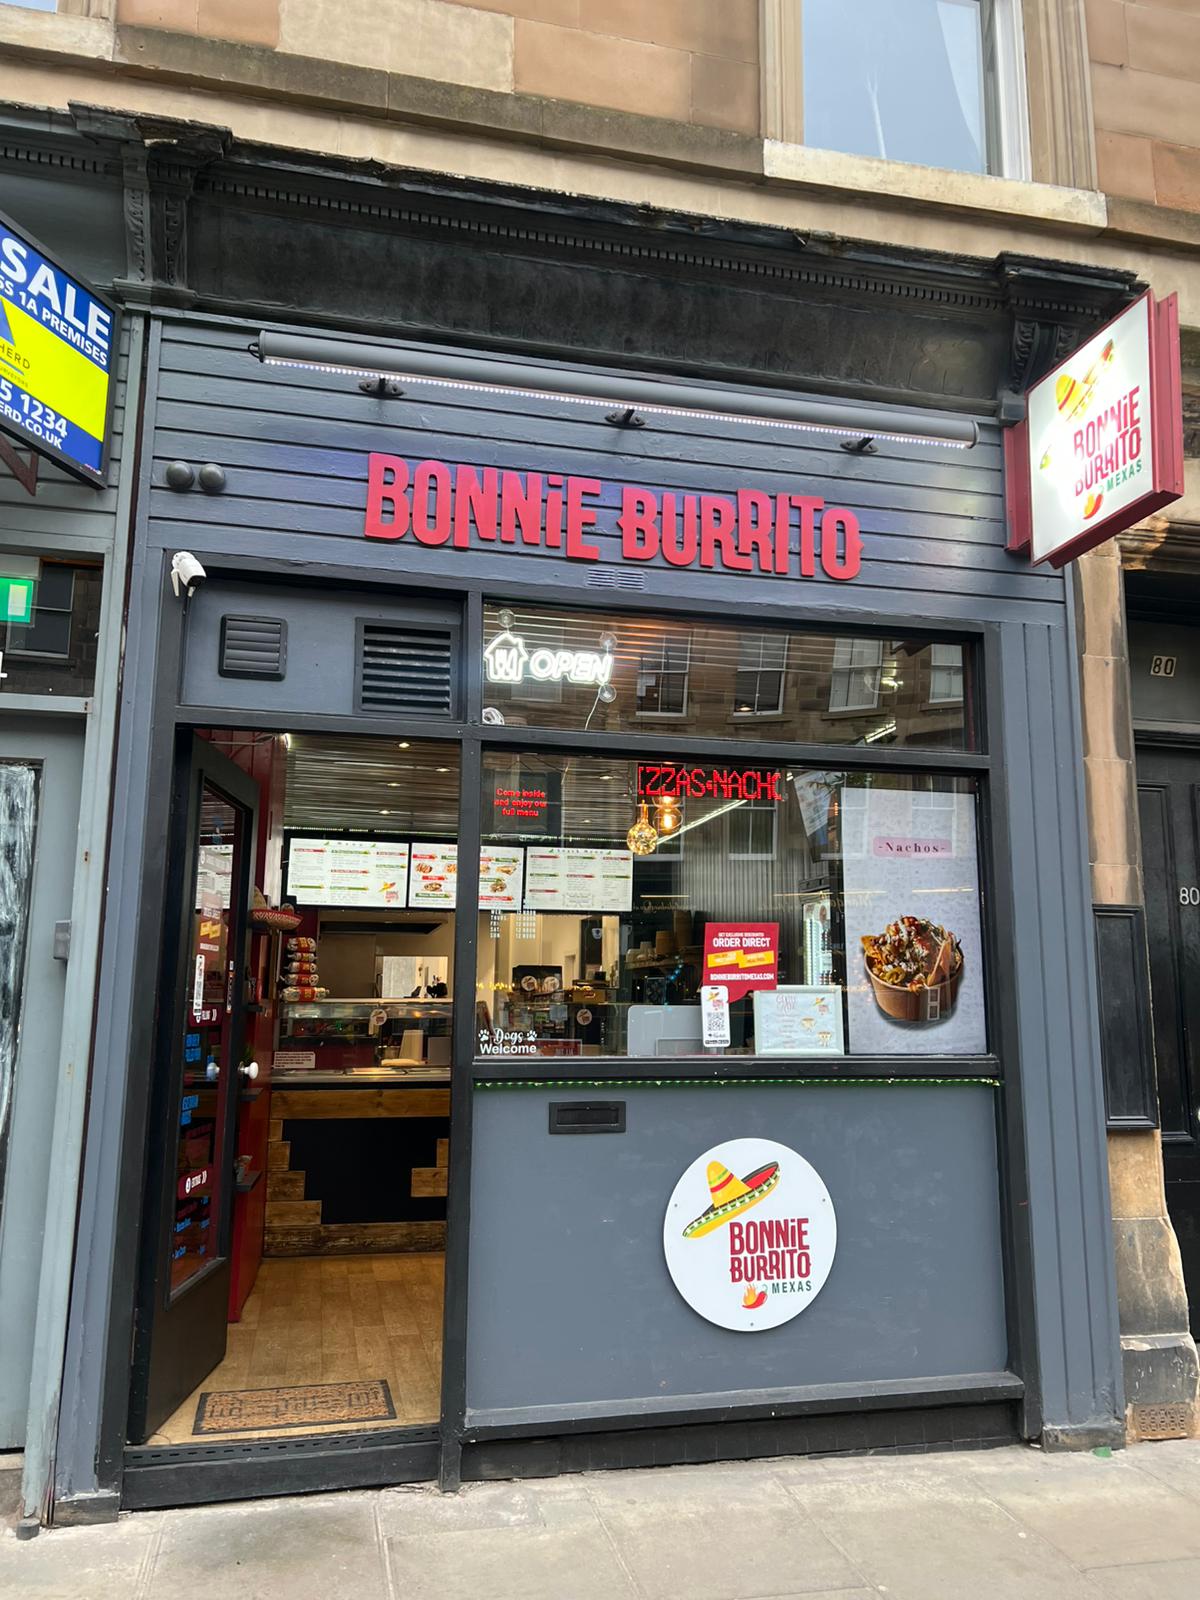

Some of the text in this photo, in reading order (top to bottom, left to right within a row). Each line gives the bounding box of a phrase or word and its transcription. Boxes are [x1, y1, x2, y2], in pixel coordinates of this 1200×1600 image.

[1, 237, 110, 350] SALE
[19, 291, 38, 316] 1A
[42, 306, 108, 366] PREMISES
[0, 378, 68, 438] 5 1234
[1107, 459, 1142, 491] MEXAS
[616, 486, 864, 580] BURRITO
[530, 649, 613, 682] OPEN
[1153, 657, 1174, 675] 80
[496, 788, 546, 798] Come inside
[502, 808, 515, 816] full
[512, 799, 533, 808] enjoy
[1180, 887, 1200, 905] 80
[713, 937, 771, 947] ORDER DIRECT
[494, 1028, 523, 1044] Dogs
[480, 1043, 537, 1054] Welcome
[729, 1249, 811, 1283] BURRITO
[771, 1280, 812, 1294] MEXAS
